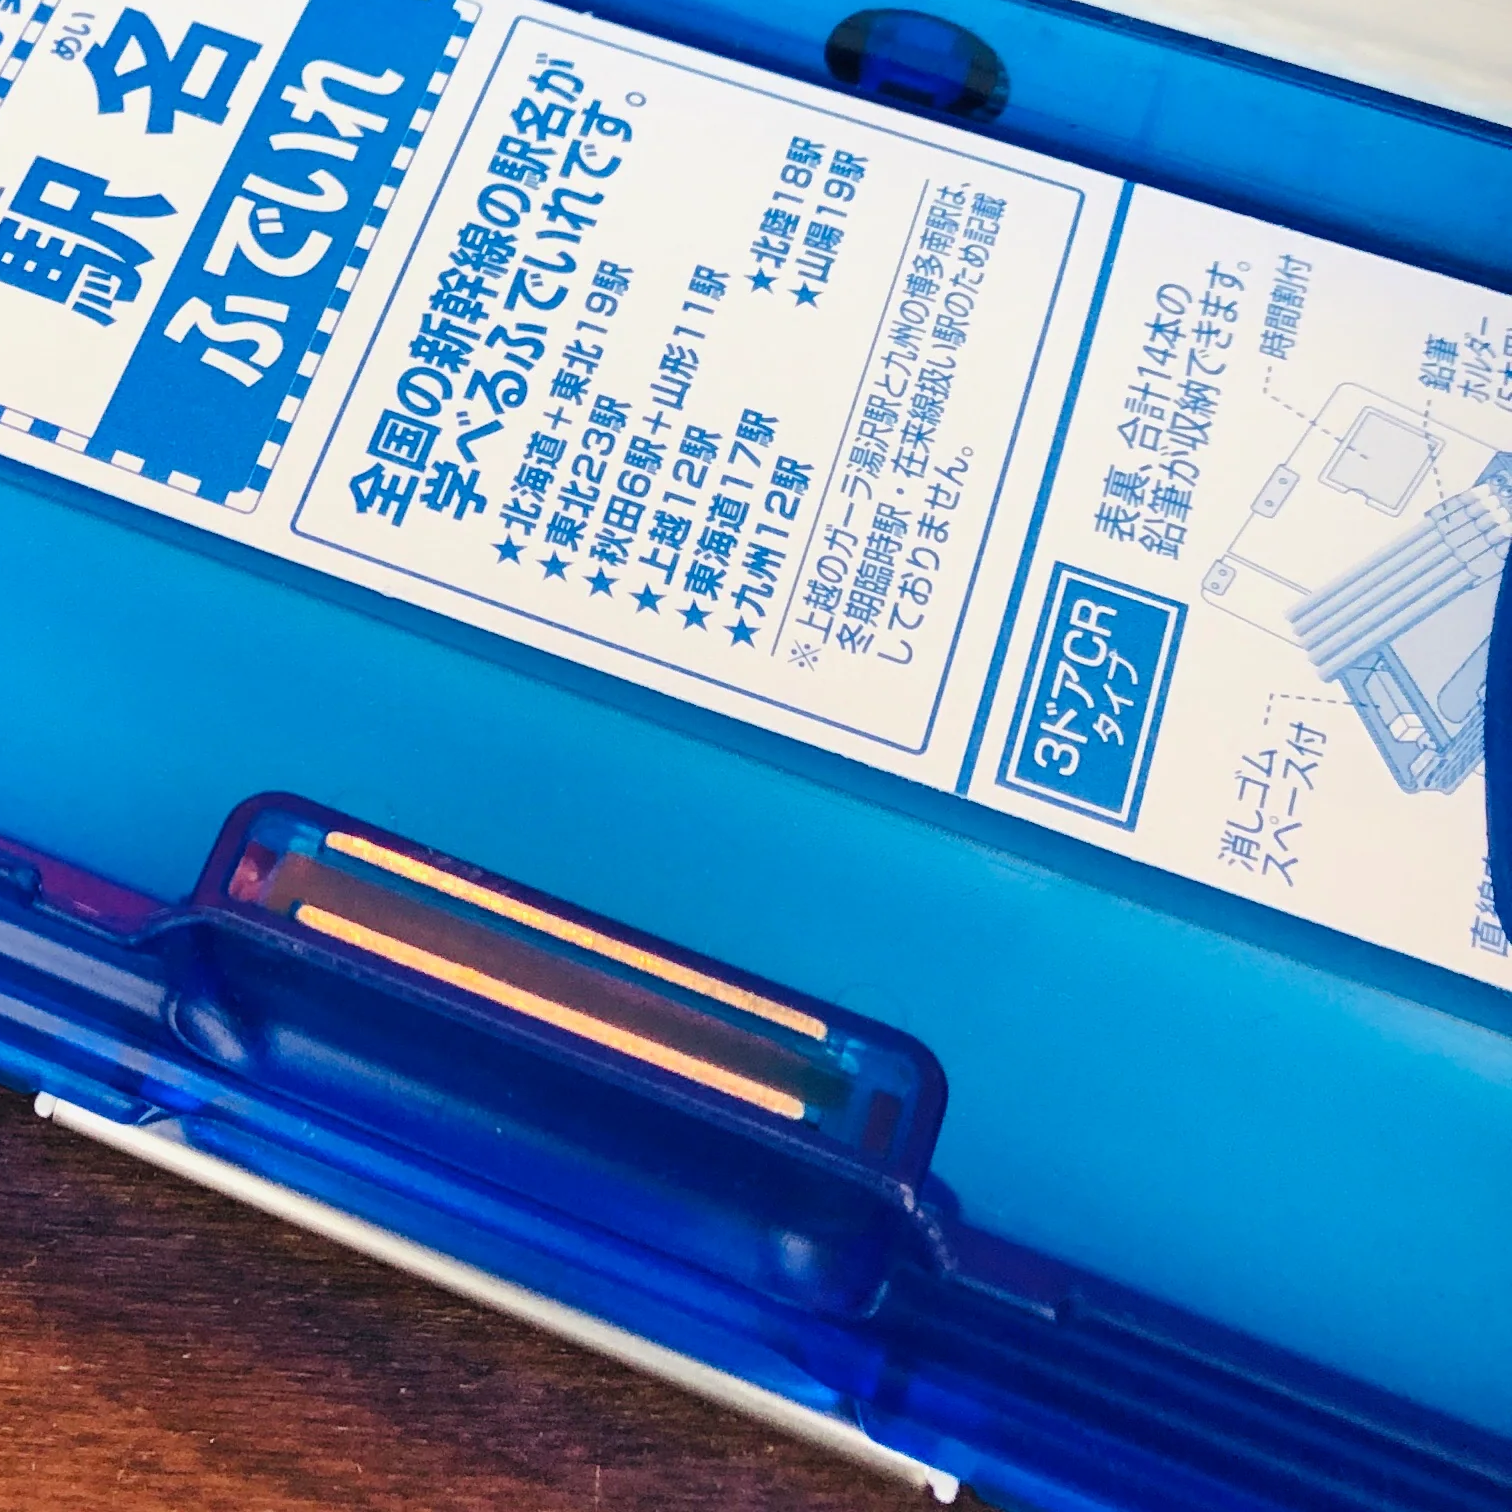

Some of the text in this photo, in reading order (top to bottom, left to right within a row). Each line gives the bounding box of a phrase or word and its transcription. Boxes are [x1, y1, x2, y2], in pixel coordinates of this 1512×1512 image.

[164, 60, 404, 387] ふでいれ
[752, 137, 824, 272] 北陸18駅
[798, 150, 866, 282] 山陽19駅
[350, 60, 584, 526] 全国の新幹線の駅名が
[419, 90, 647, 521] 学べるふでいれです。
[1260, 255, 1311, 359] 時間割付
[1418, 333, 1459, 393] 鉛筆
[1457, 316, 1497, 403] ホルダー
[545, 395, 630, 551] 東北23駅
[1138, 260, 1251, 560] 鉛筆が収納できます。
[641, 426, 721, 585] 上越12駅
[684, 409, 777, 600] 東海道17駅
[732, 456, 813, 616] 九州12駅
[877, 446, 974, 665] しておりません。
[1034, 599, 1117, 775] 3ドアCR
[1093, 650, 1138, 745] タイプ
[1218, 748, 1278, 872] 消しゴム
[1263, 722, 1326, 886] スペース付
